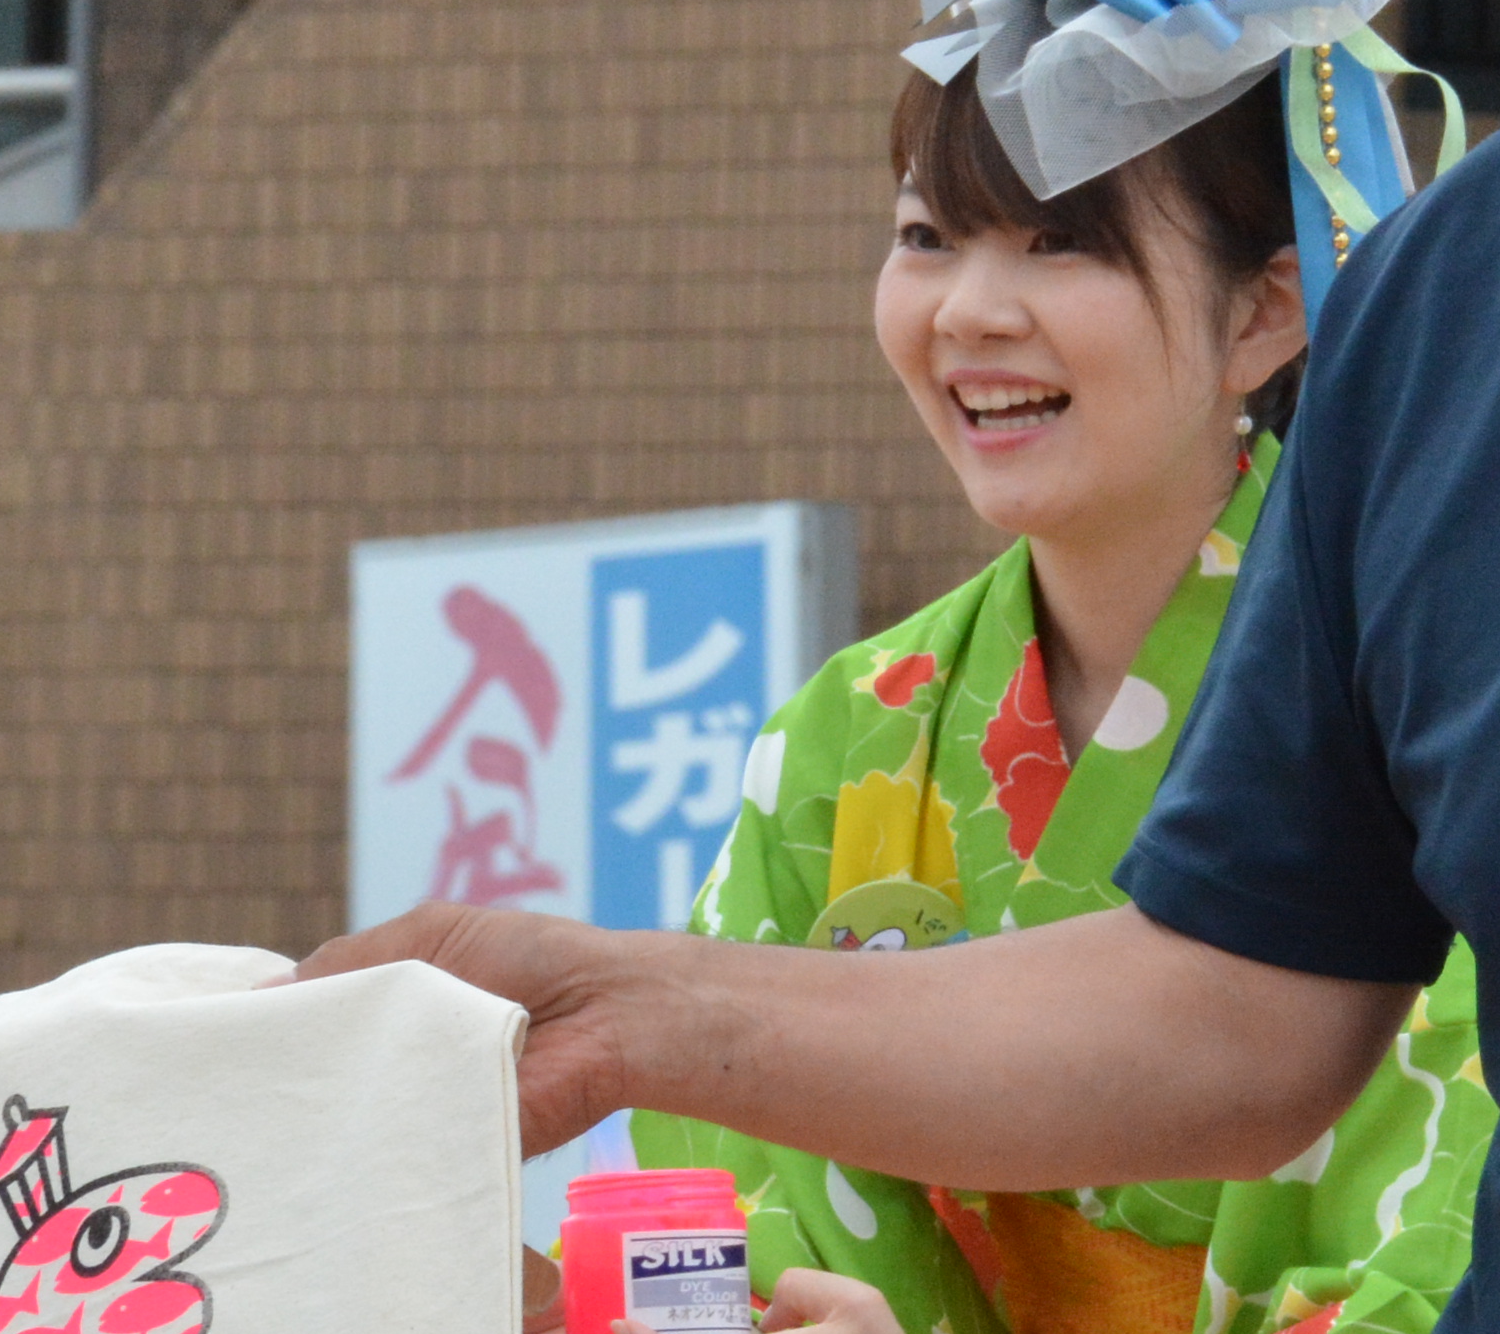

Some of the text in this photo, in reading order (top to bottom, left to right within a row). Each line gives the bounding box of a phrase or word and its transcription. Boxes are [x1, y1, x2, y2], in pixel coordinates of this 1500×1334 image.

[640, 1240, 727, 1269] SILK
[680, 1280, 712, 1292] DYE
[691, 1290, 739, 1304] COLOR
